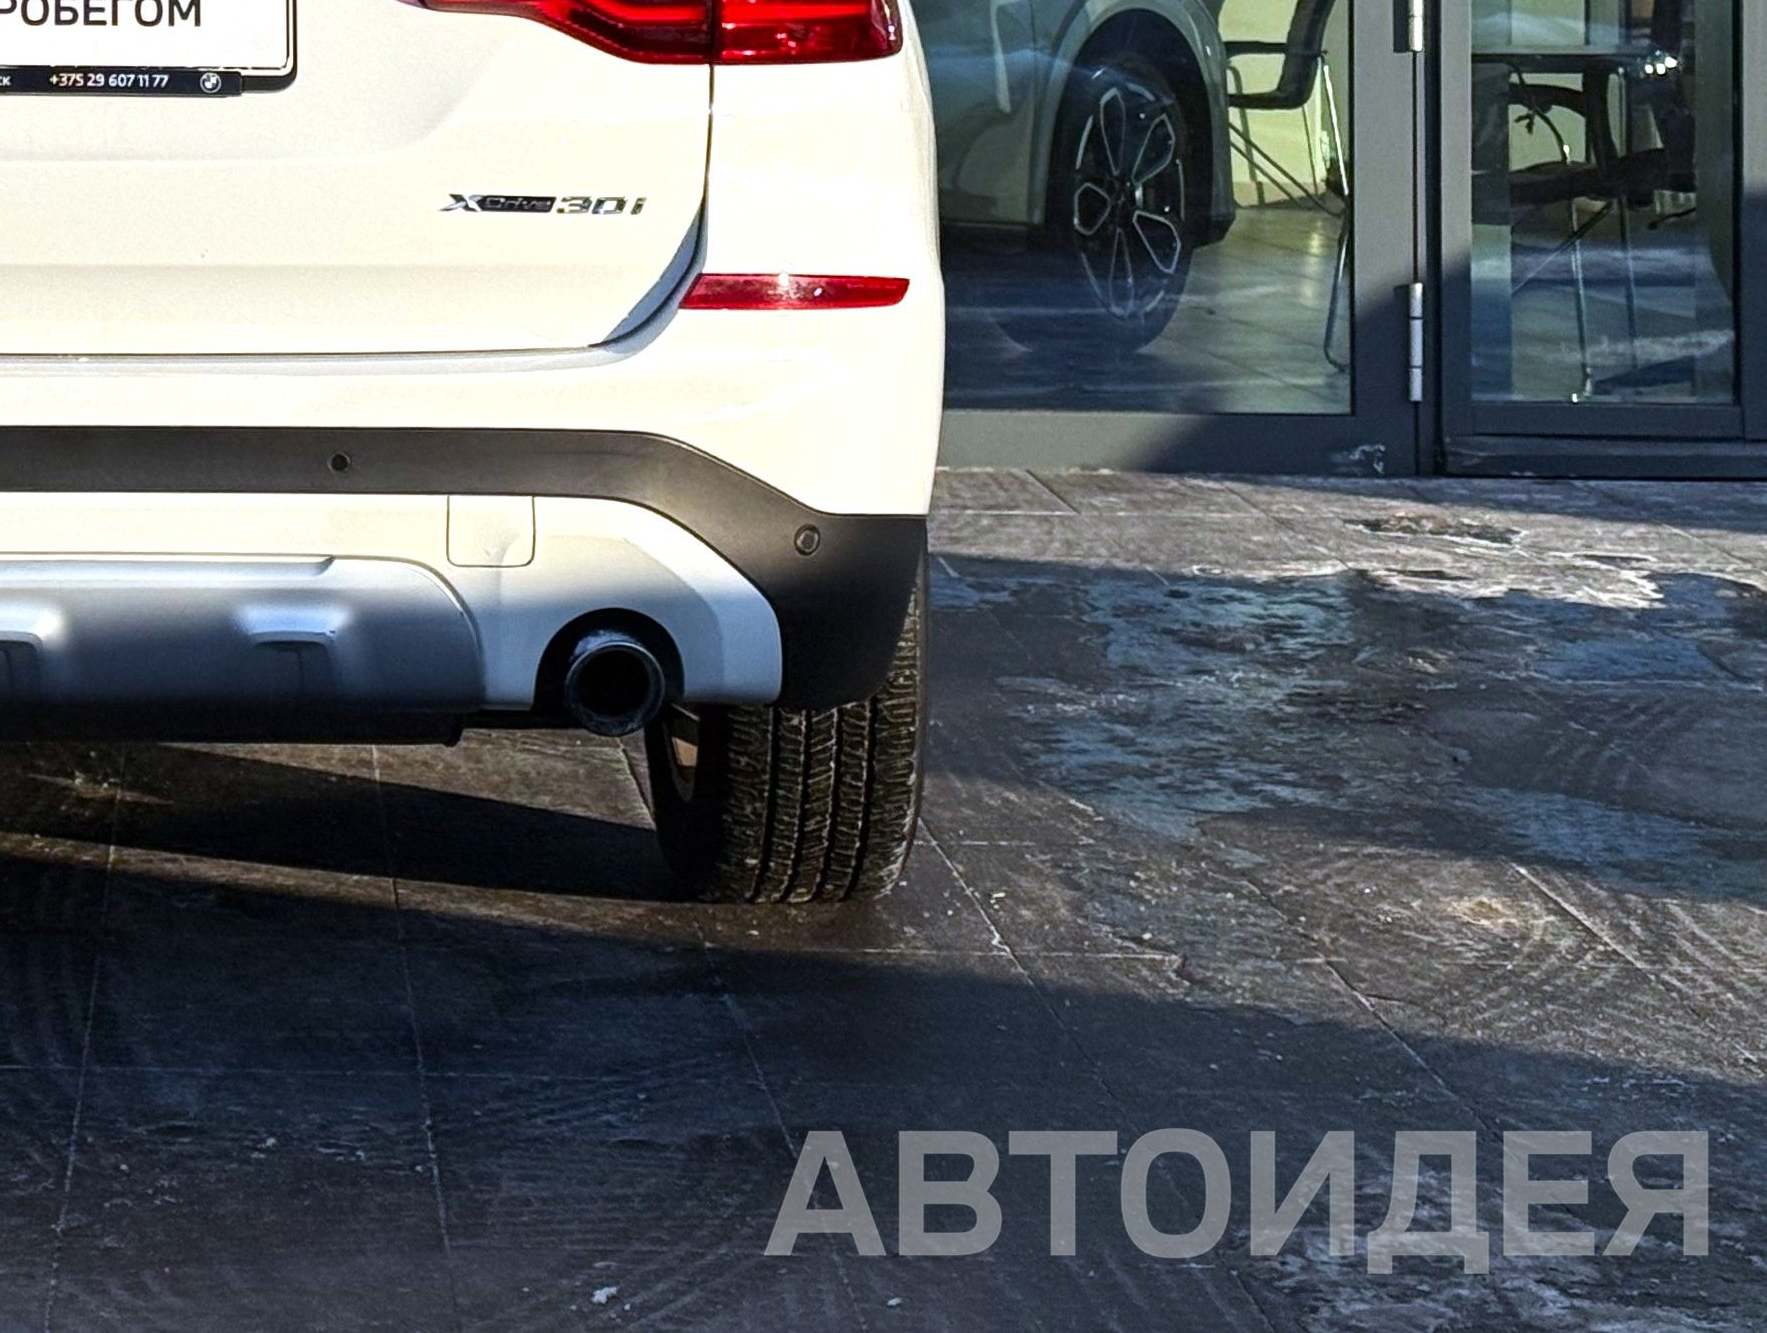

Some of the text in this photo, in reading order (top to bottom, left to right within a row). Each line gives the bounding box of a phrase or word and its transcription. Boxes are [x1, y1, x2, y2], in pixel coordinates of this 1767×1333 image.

[49, 72, 84, 87] +375
[86, 72, 105, 87] 29
[108, 72, 134, 87] 607
